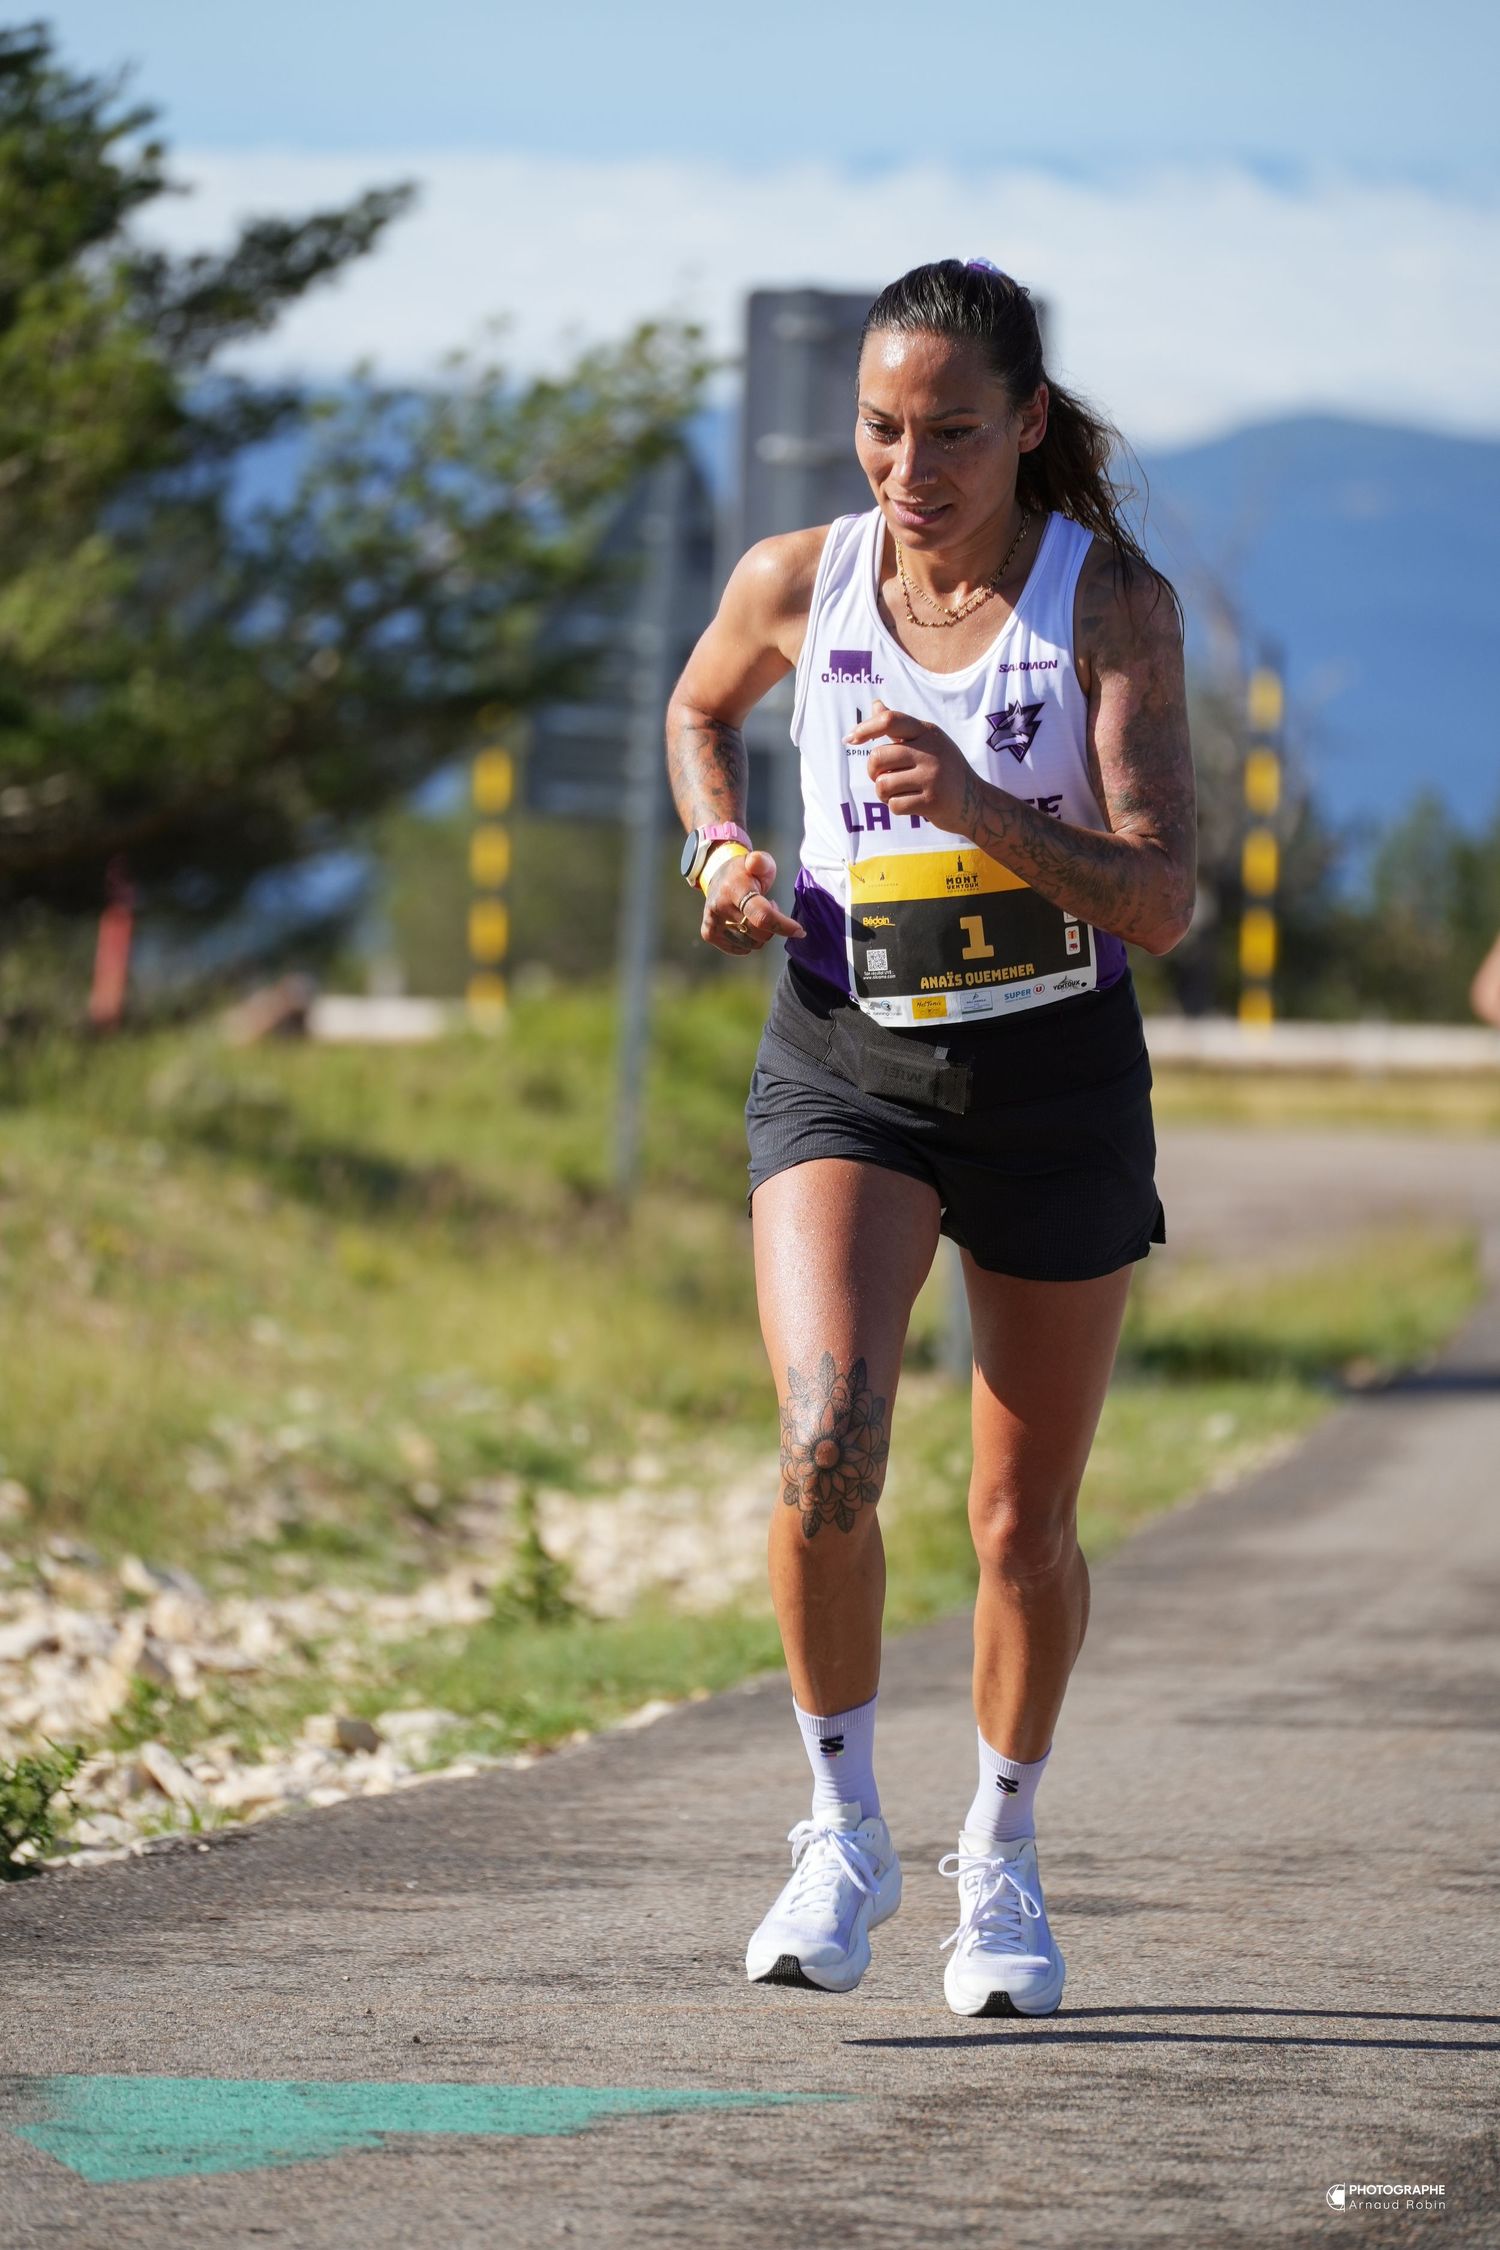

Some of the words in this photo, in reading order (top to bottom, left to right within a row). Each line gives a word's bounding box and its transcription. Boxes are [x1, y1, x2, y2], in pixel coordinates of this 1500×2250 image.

[821, 667, 884, 684] ablock.fr
[840, 802, 891, 833] LA
[945, 875, 978, 885] MONT
[959, 915, 995, 960] 1
[920, 971, 963, 990] ANAÏS
[965, 963, 1035, 986] QUEMENER
[1004, 988, 1031, 1001] SUPER
